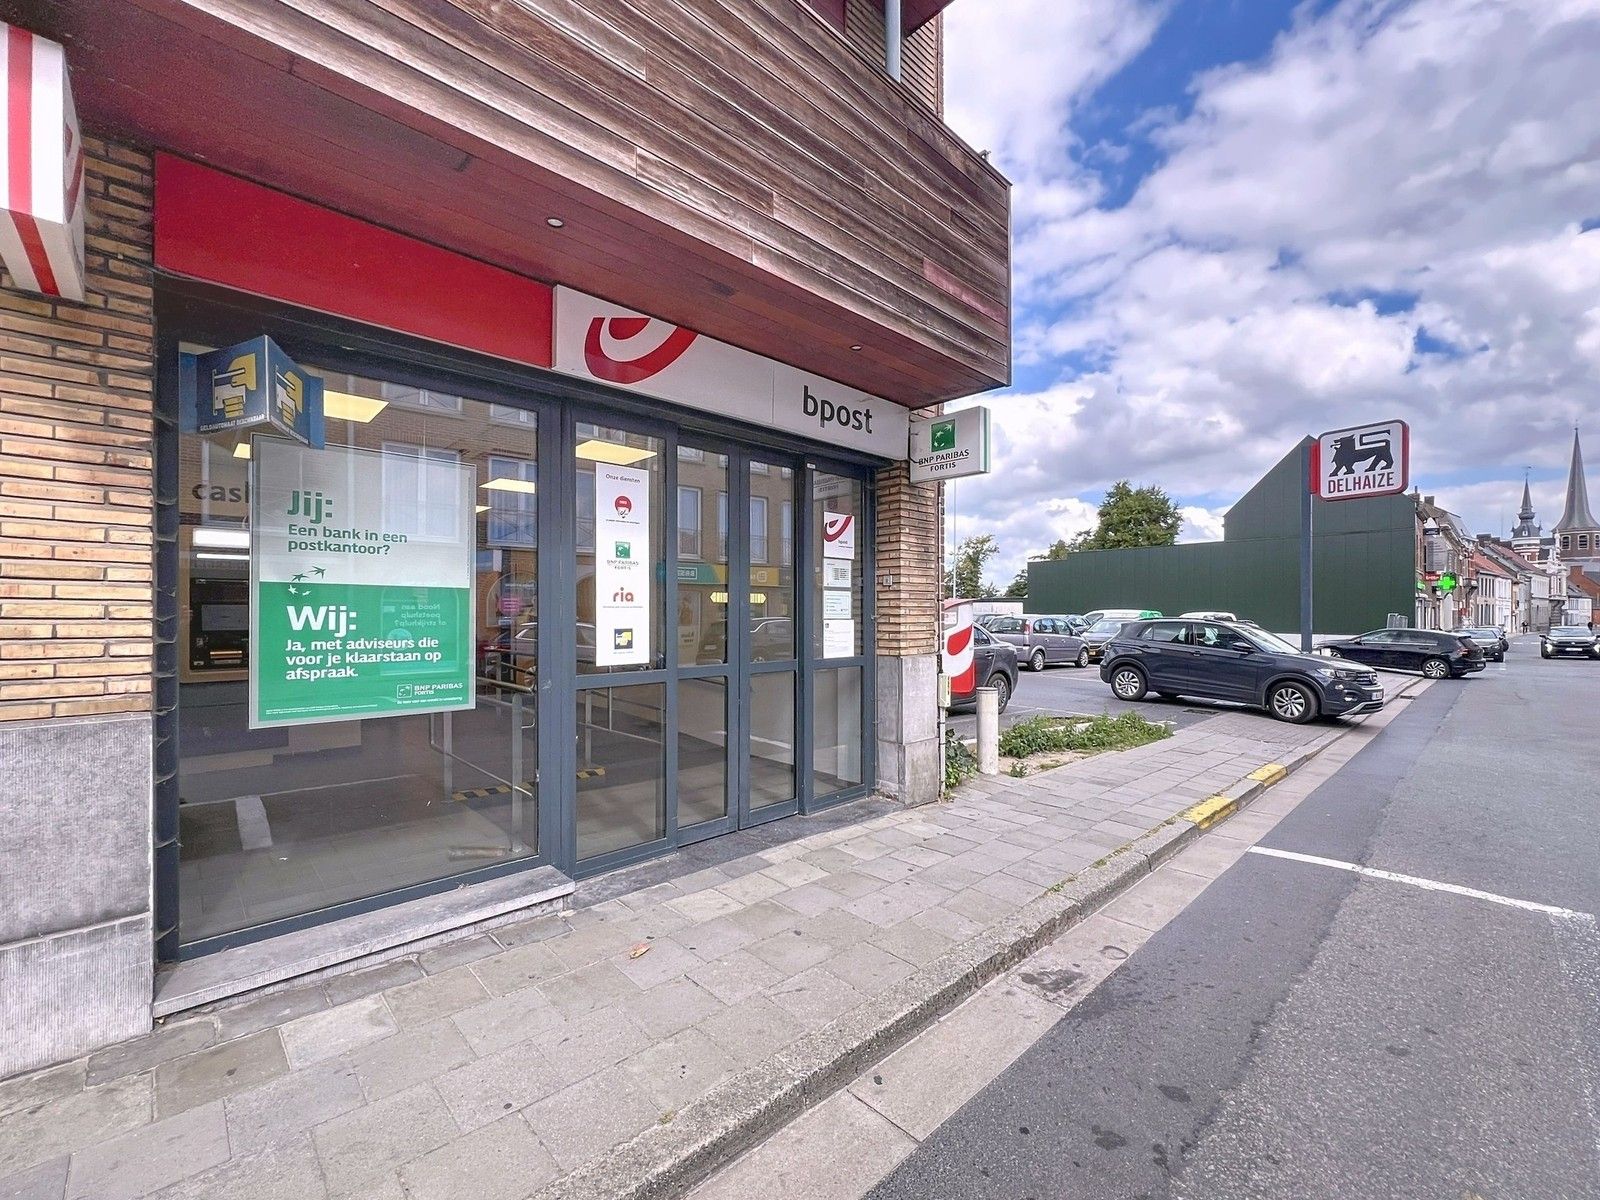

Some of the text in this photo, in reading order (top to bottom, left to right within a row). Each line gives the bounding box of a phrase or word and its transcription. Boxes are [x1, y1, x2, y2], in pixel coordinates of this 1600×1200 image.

[802, 385, 873, 434] bpost
[919, 449, 969, 465] BNP PARIBAS
[930, 462, 956, 471] FORTIS
[1328, 472, 1394, 493] DELHAIZE
[287, 490, 332, 524] Jij:
[288, 524, 408, 543] Een bank in een
[288, 540, 390, 555] postkantoor?
[613, 586, 634, 602] ria
[286, 605, 357, 637] Wij:
[286, 637, 439, 653] Ja, met adviseurs die
[286, 652, 442, 667] voor je klaarstaan op
[285, 667, 358, 681] afspraak.
